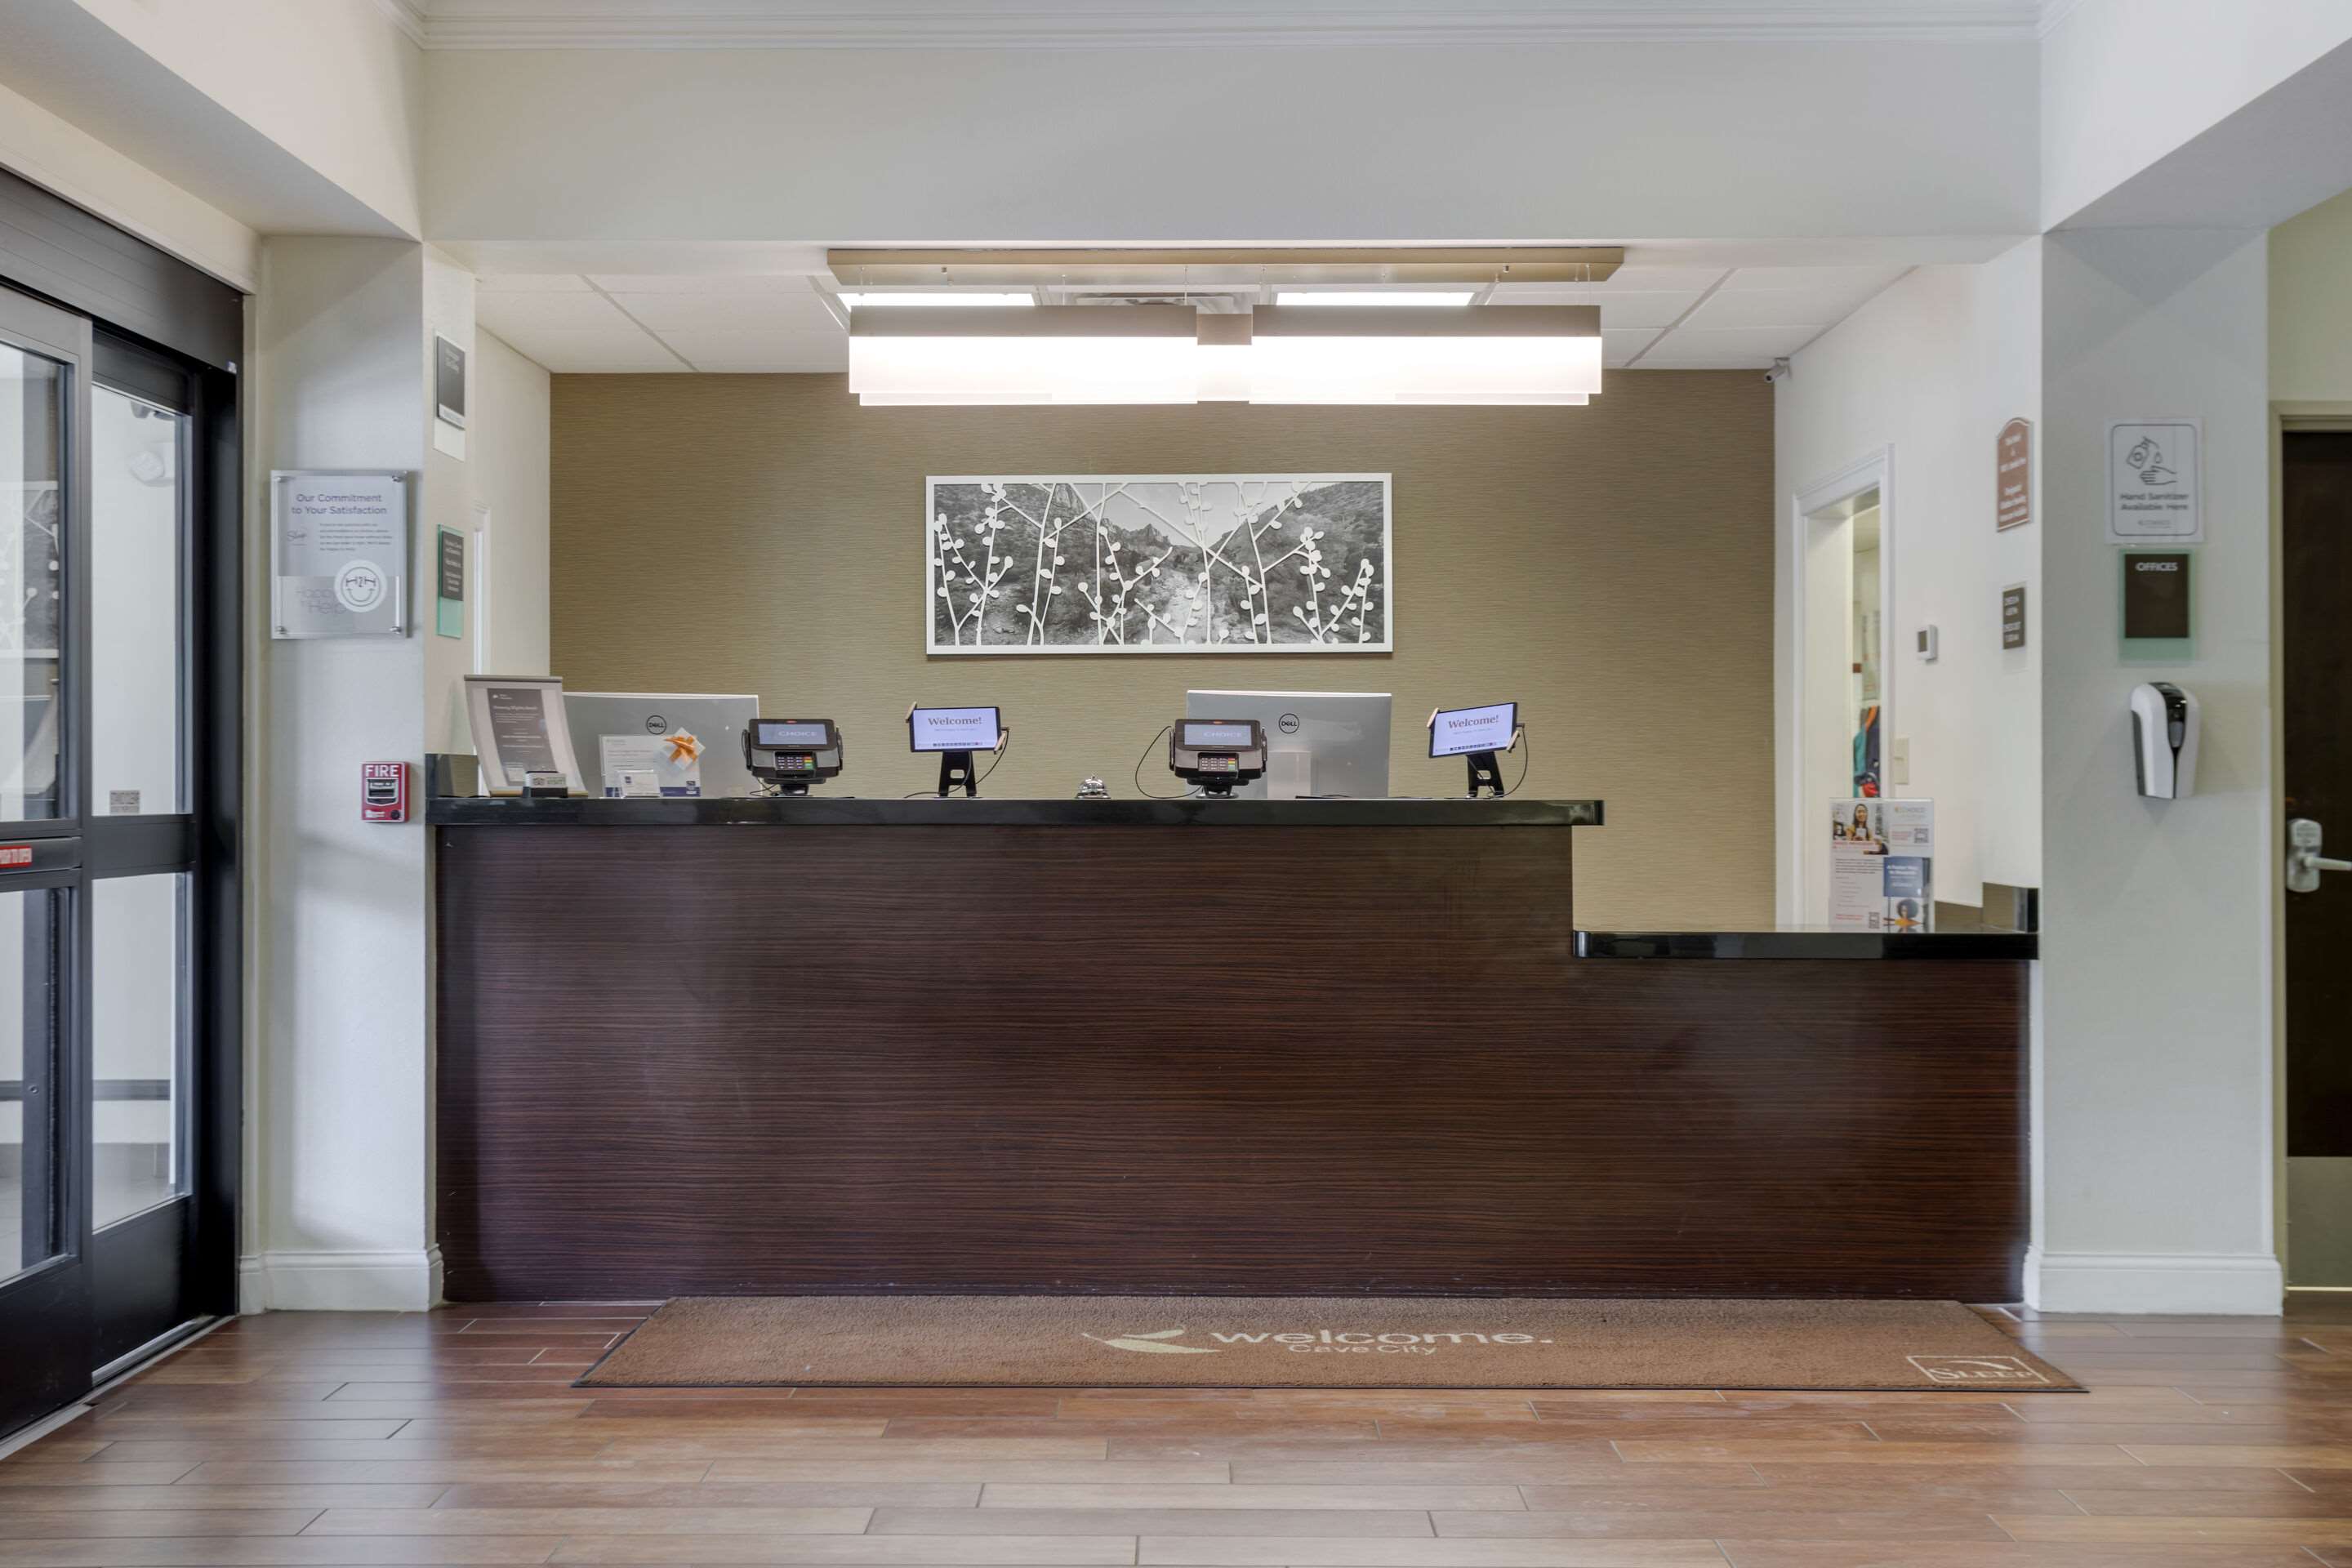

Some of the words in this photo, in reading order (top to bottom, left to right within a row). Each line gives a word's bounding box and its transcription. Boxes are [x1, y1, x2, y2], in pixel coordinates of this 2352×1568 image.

[296, 493, 315, 502] Our
[318, 493, 382, 502] Commitment
[291, 506, 303, 514] to
[305, 506, 327, 514] Your
[329, 506, 387, 514] Satisfaction
[2135, 562, 2179, 572] OFFICES
[928, 717, 982, 726] Welcome!
[1448, 715, 1499, 728] Welcome!
[365, 764, 399, 777] FIRE
[1209, 1329, 1553, 1344] welcome.
[1288, 1344, 1370, 1354] Cave
[1376, 1344, 1438, 1356] City
